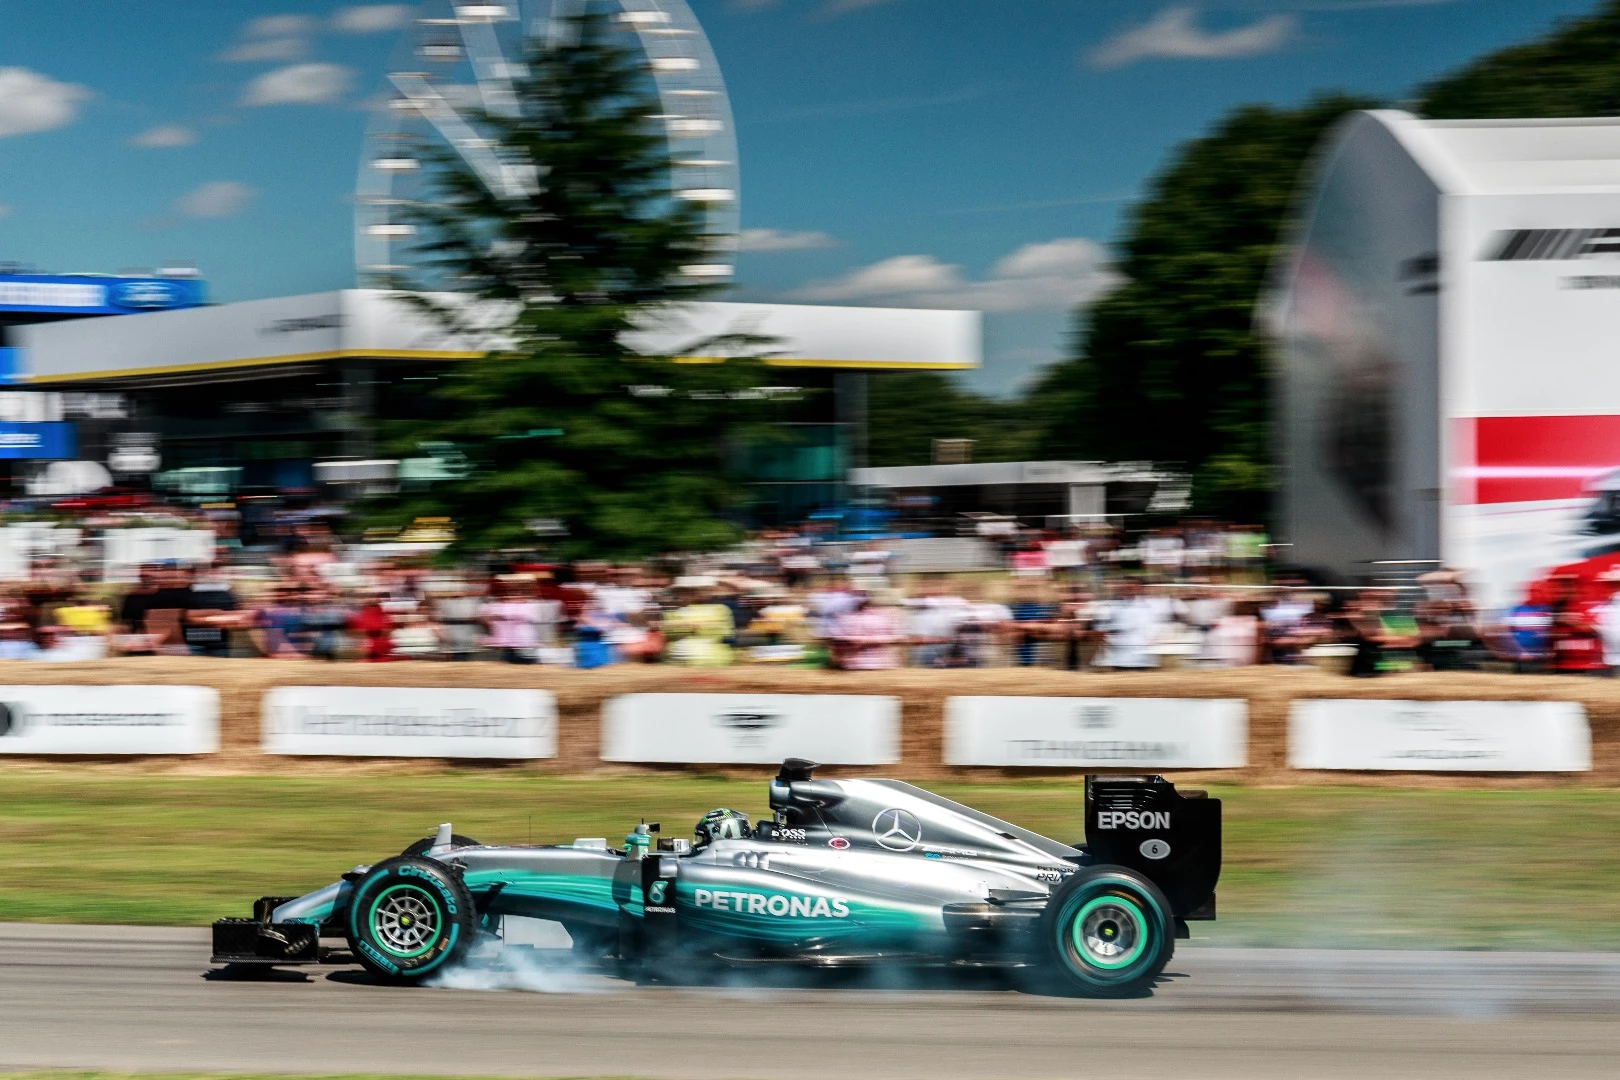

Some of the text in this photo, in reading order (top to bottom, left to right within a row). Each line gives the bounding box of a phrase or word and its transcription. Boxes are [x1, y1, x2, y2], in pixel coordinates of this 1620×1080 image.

[1097, 811, 1171, 830] EPSON
[1151, 844, 1158, 854] 6
[1037, 865, 1079, 874] PETRON
[694, 888, 850, 918] PETRONAS
